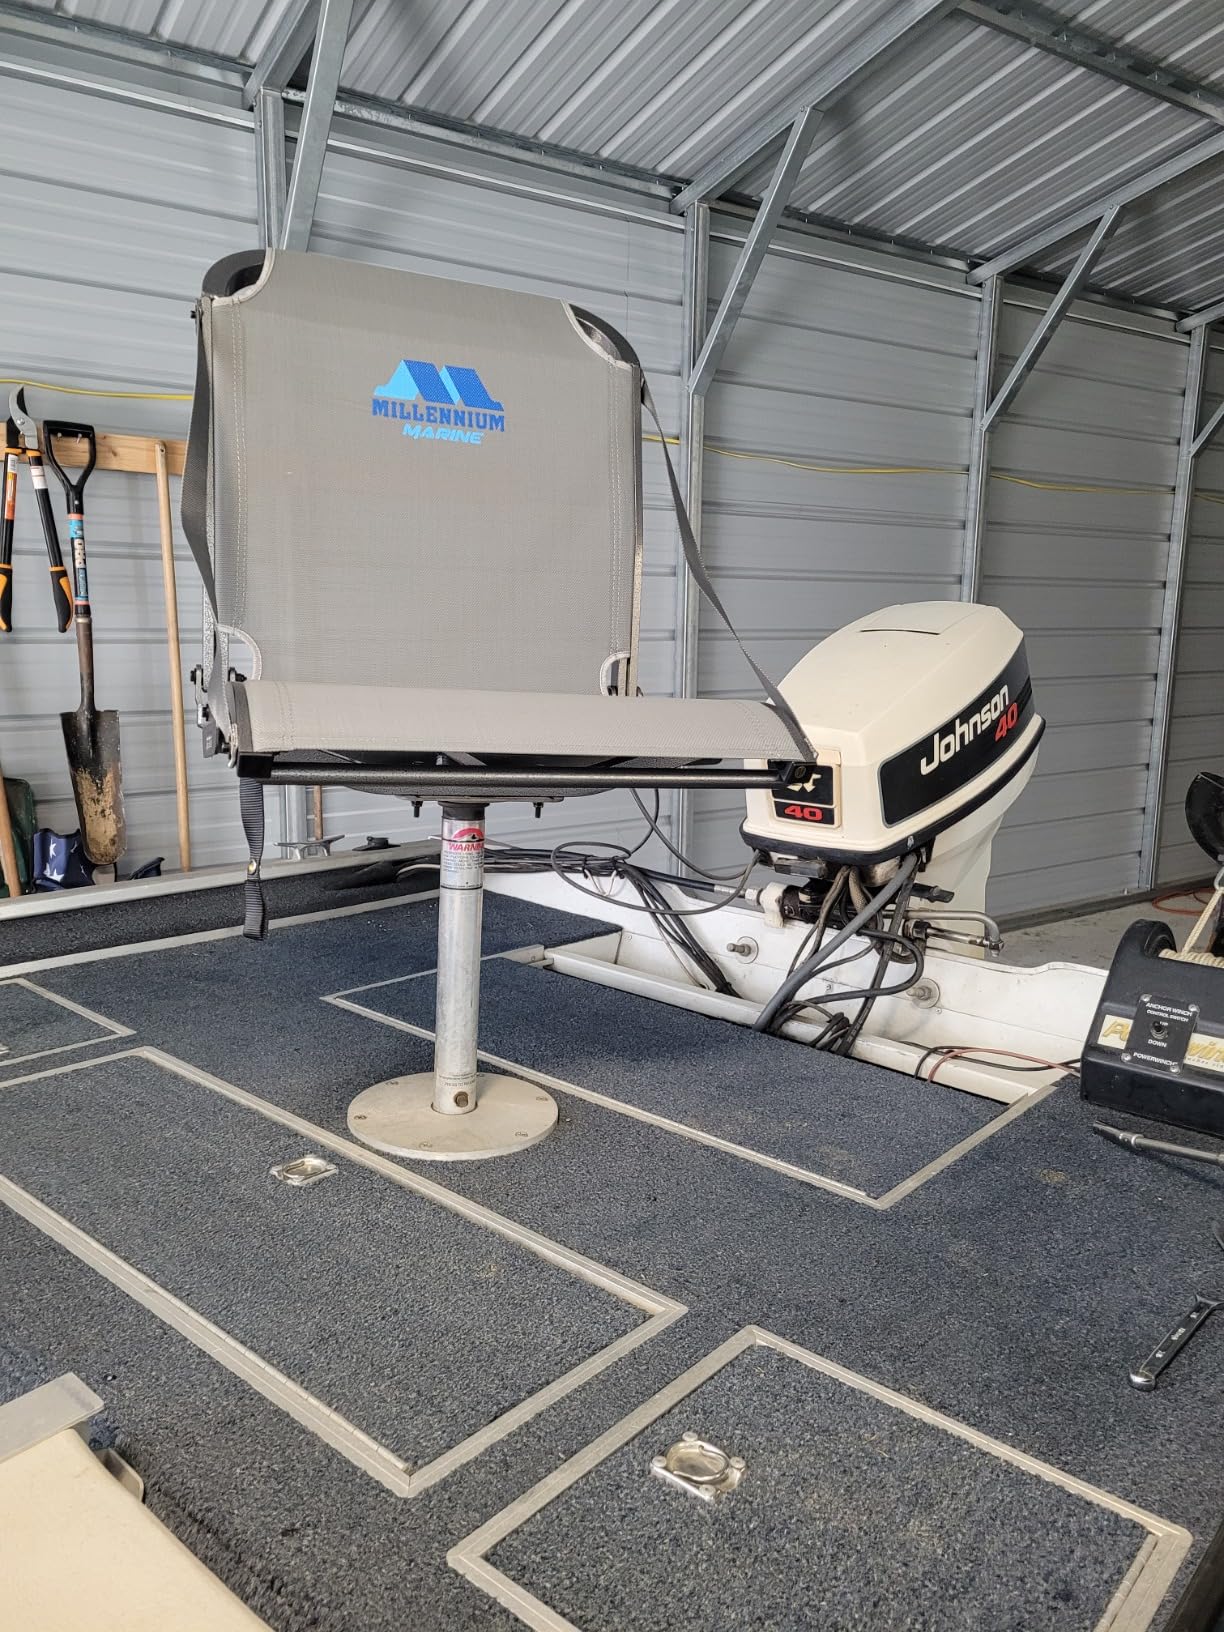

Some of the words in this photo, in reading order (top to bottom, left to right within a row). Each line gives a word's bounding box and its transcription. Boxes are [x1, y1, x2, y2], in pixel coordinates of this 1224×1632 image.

[372, 398, 505, 432] MILLENNIUM
[402, 423, 485, 445] MARINE
[920, 684, 1009, 776] Johnson
[994, 702, 1018, 741] 40
[784, 805, 823, 822] 40
[1146, 1002, 1172, 1013] ANCHOR
[1172, 1007, 1193, 1017] WINCH
[1146, 1009, 1169, 1018] CONTROL
[1169, 1014, 1189, 1022] SWITCH
[1147, 1038, 1168, 1048] DOWN
